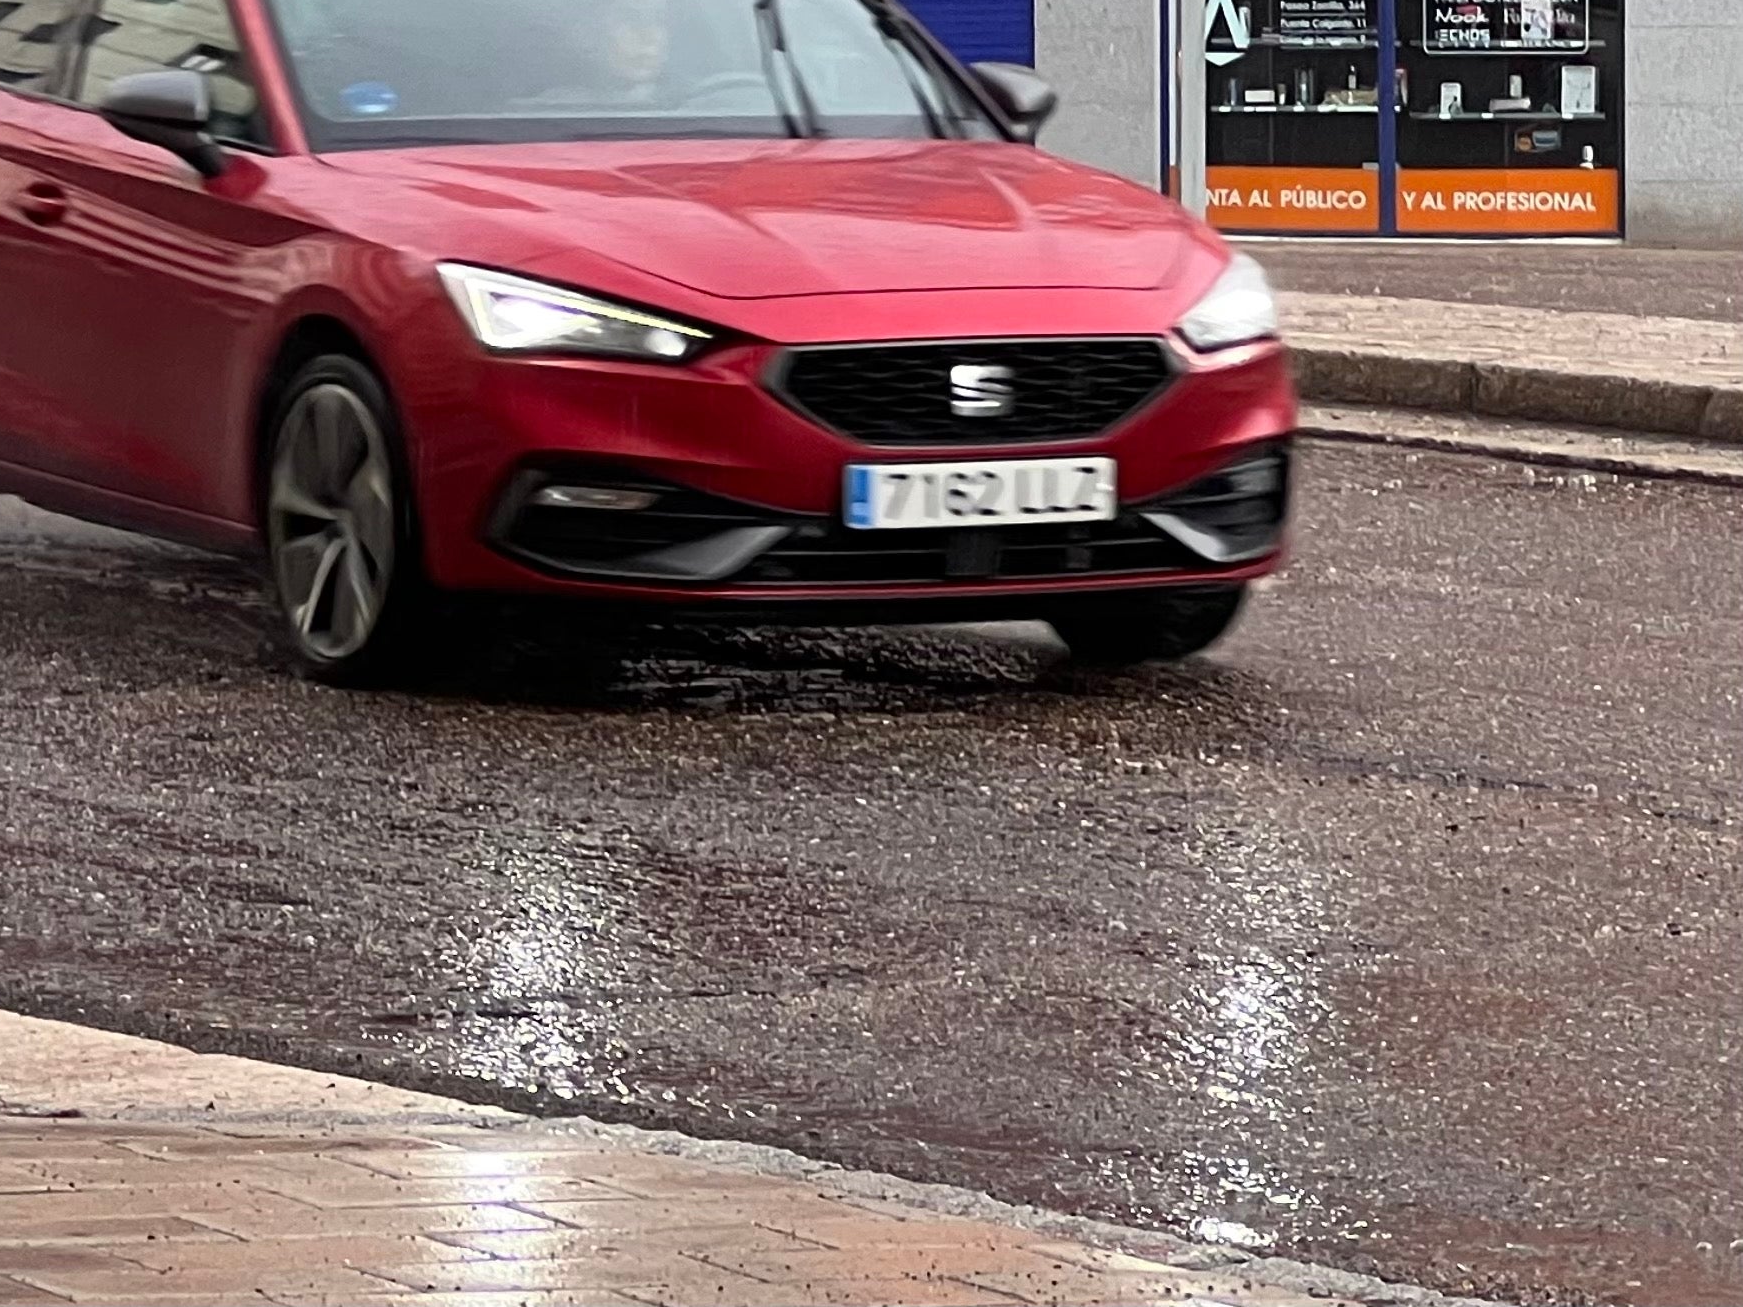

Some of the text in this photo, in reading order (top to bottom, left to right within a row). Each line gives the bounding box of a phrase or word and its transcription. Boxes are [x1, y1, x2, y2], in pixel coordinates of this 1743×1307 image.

[1248, 189, 1273, 208] AL
[1280, 184, 1367, 210] PÚBLICO
[1403, 191, 1596, 213] Y AL PROFESIONAL
[881, 469, 1005, 521] 7162
